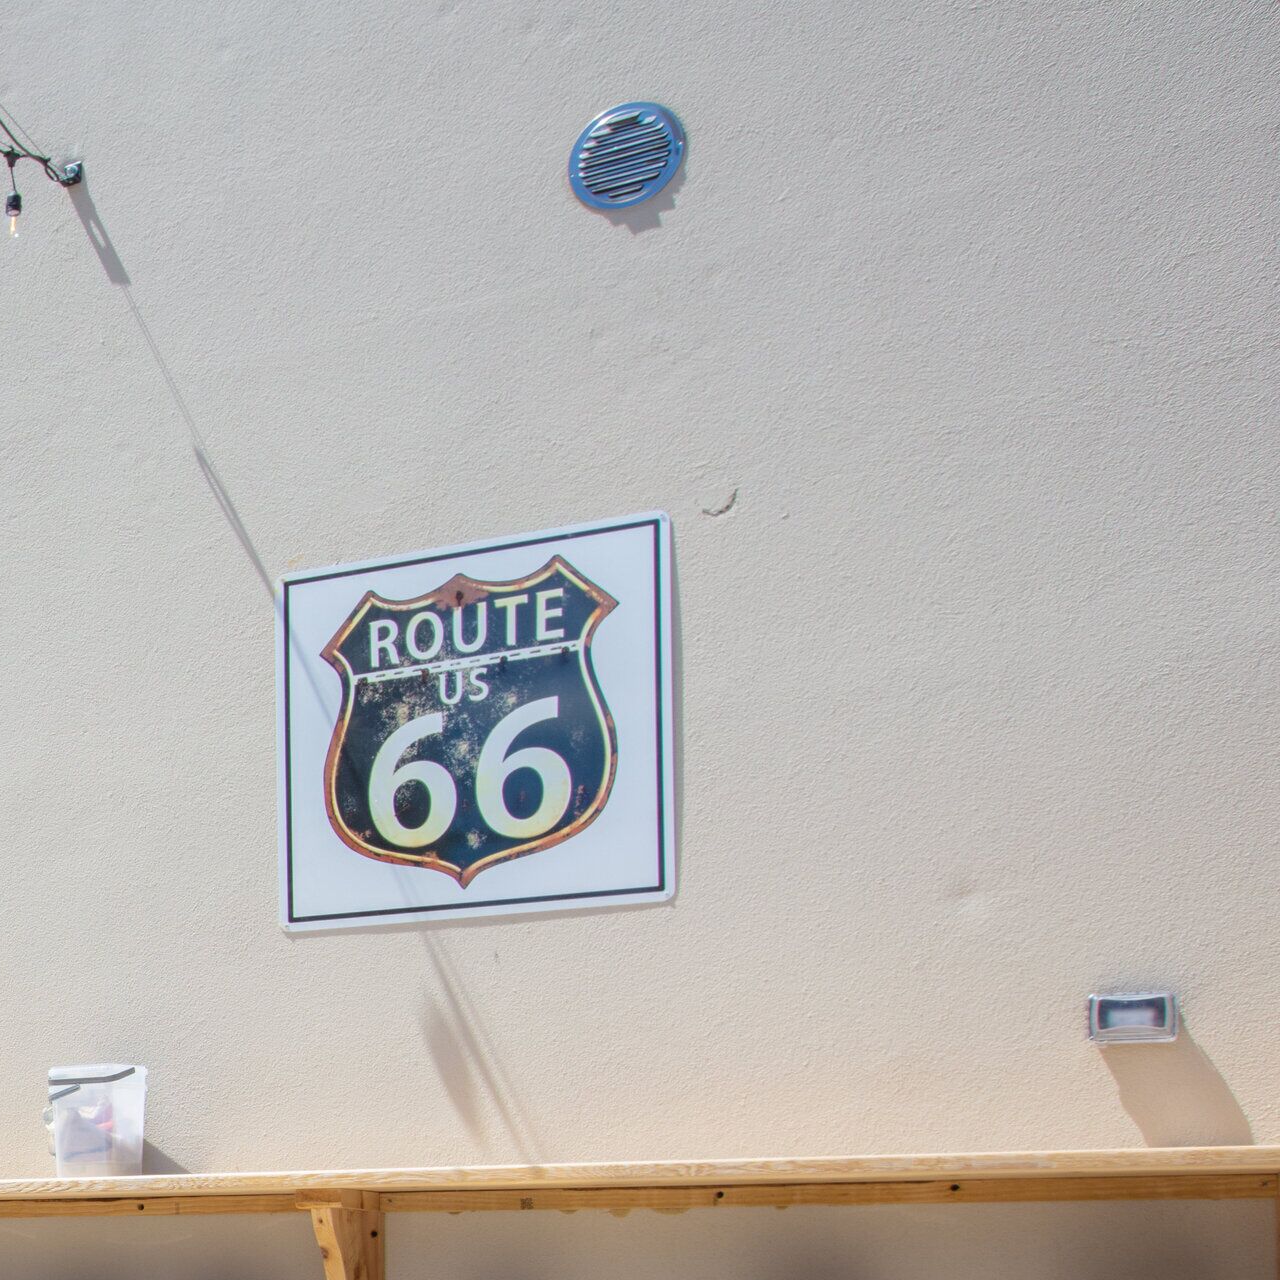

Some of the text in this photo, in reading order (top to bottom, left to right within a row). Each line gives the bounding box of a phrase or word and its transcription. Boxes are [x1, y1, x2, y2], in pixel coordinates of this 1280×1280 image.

[368, 587, 566, 669] ROUTE
[439, 666, 490, 706] US
[367, 694, 573, 849] 66
